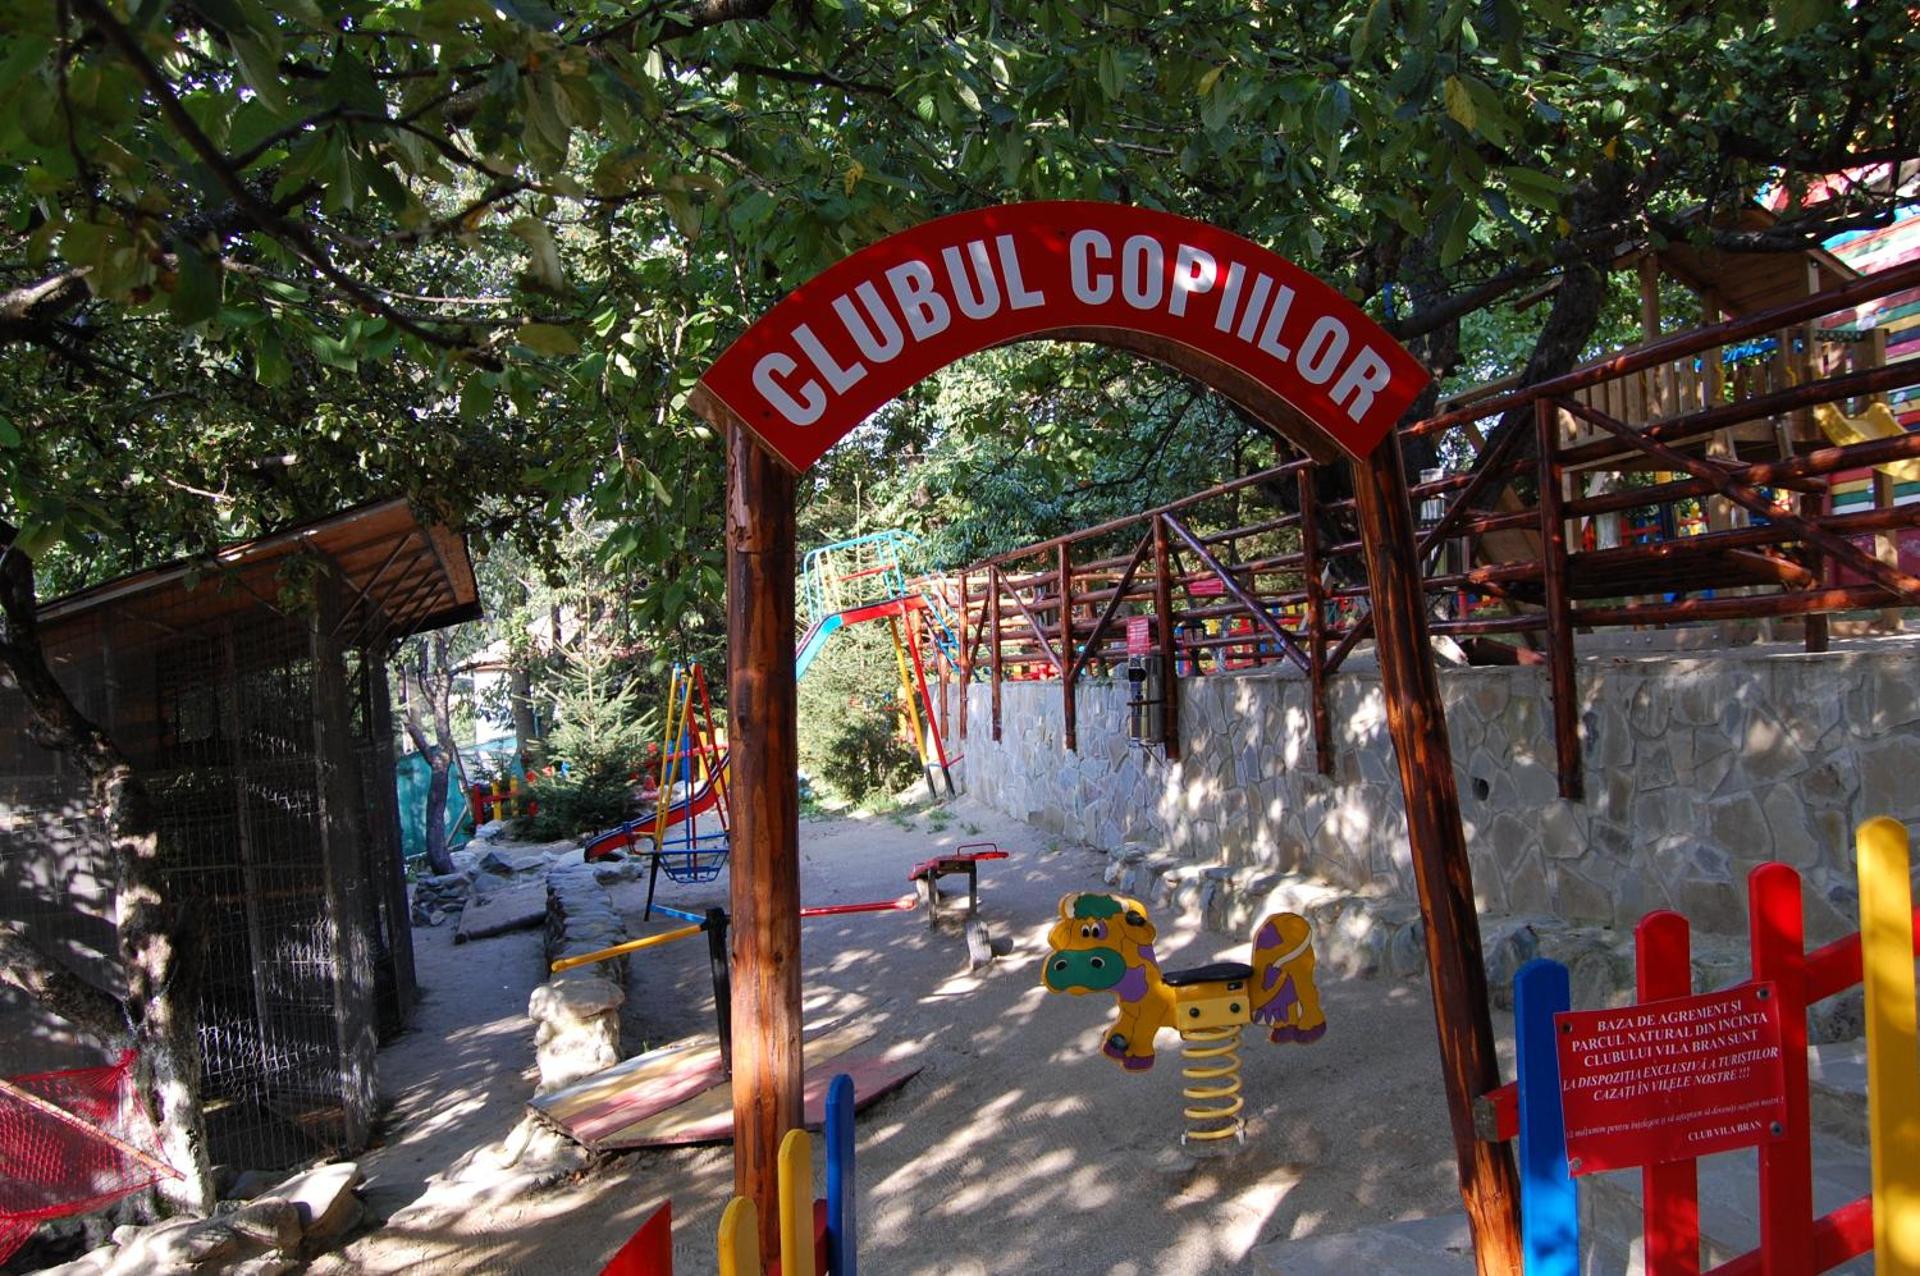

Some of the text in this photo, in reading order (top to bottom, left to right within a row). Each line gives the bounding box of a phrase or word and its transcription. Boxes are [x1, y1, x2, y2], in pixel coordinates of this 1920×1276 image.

[752, 230, 1391, 426] CLUBUL COPIILOR
[1572, 1012, 1768, 1052] PARCUL NATURAL DIN INCINTA
[1598, 1018, 1633, 1032] BAZA
[1637, 1014, 1655, 1027] DE
[1658, 1002, 1728, 1025] AGREMENT
[1584, 1029, 1758, 1067] CLUBULUI VILA BRAN SUNT
[1563, 1078, 1576, 1092] LA
[1708, 1059, 1716, 1069] A
[1652, 1075, 1690, 1092] VILELE
[1694, 1070, 1737, 1085] NOSTRE
[1739, 1066, 1750, 1079] !!!
[1688, 1120, 1762, 1141] CLUB VILA BRAN
